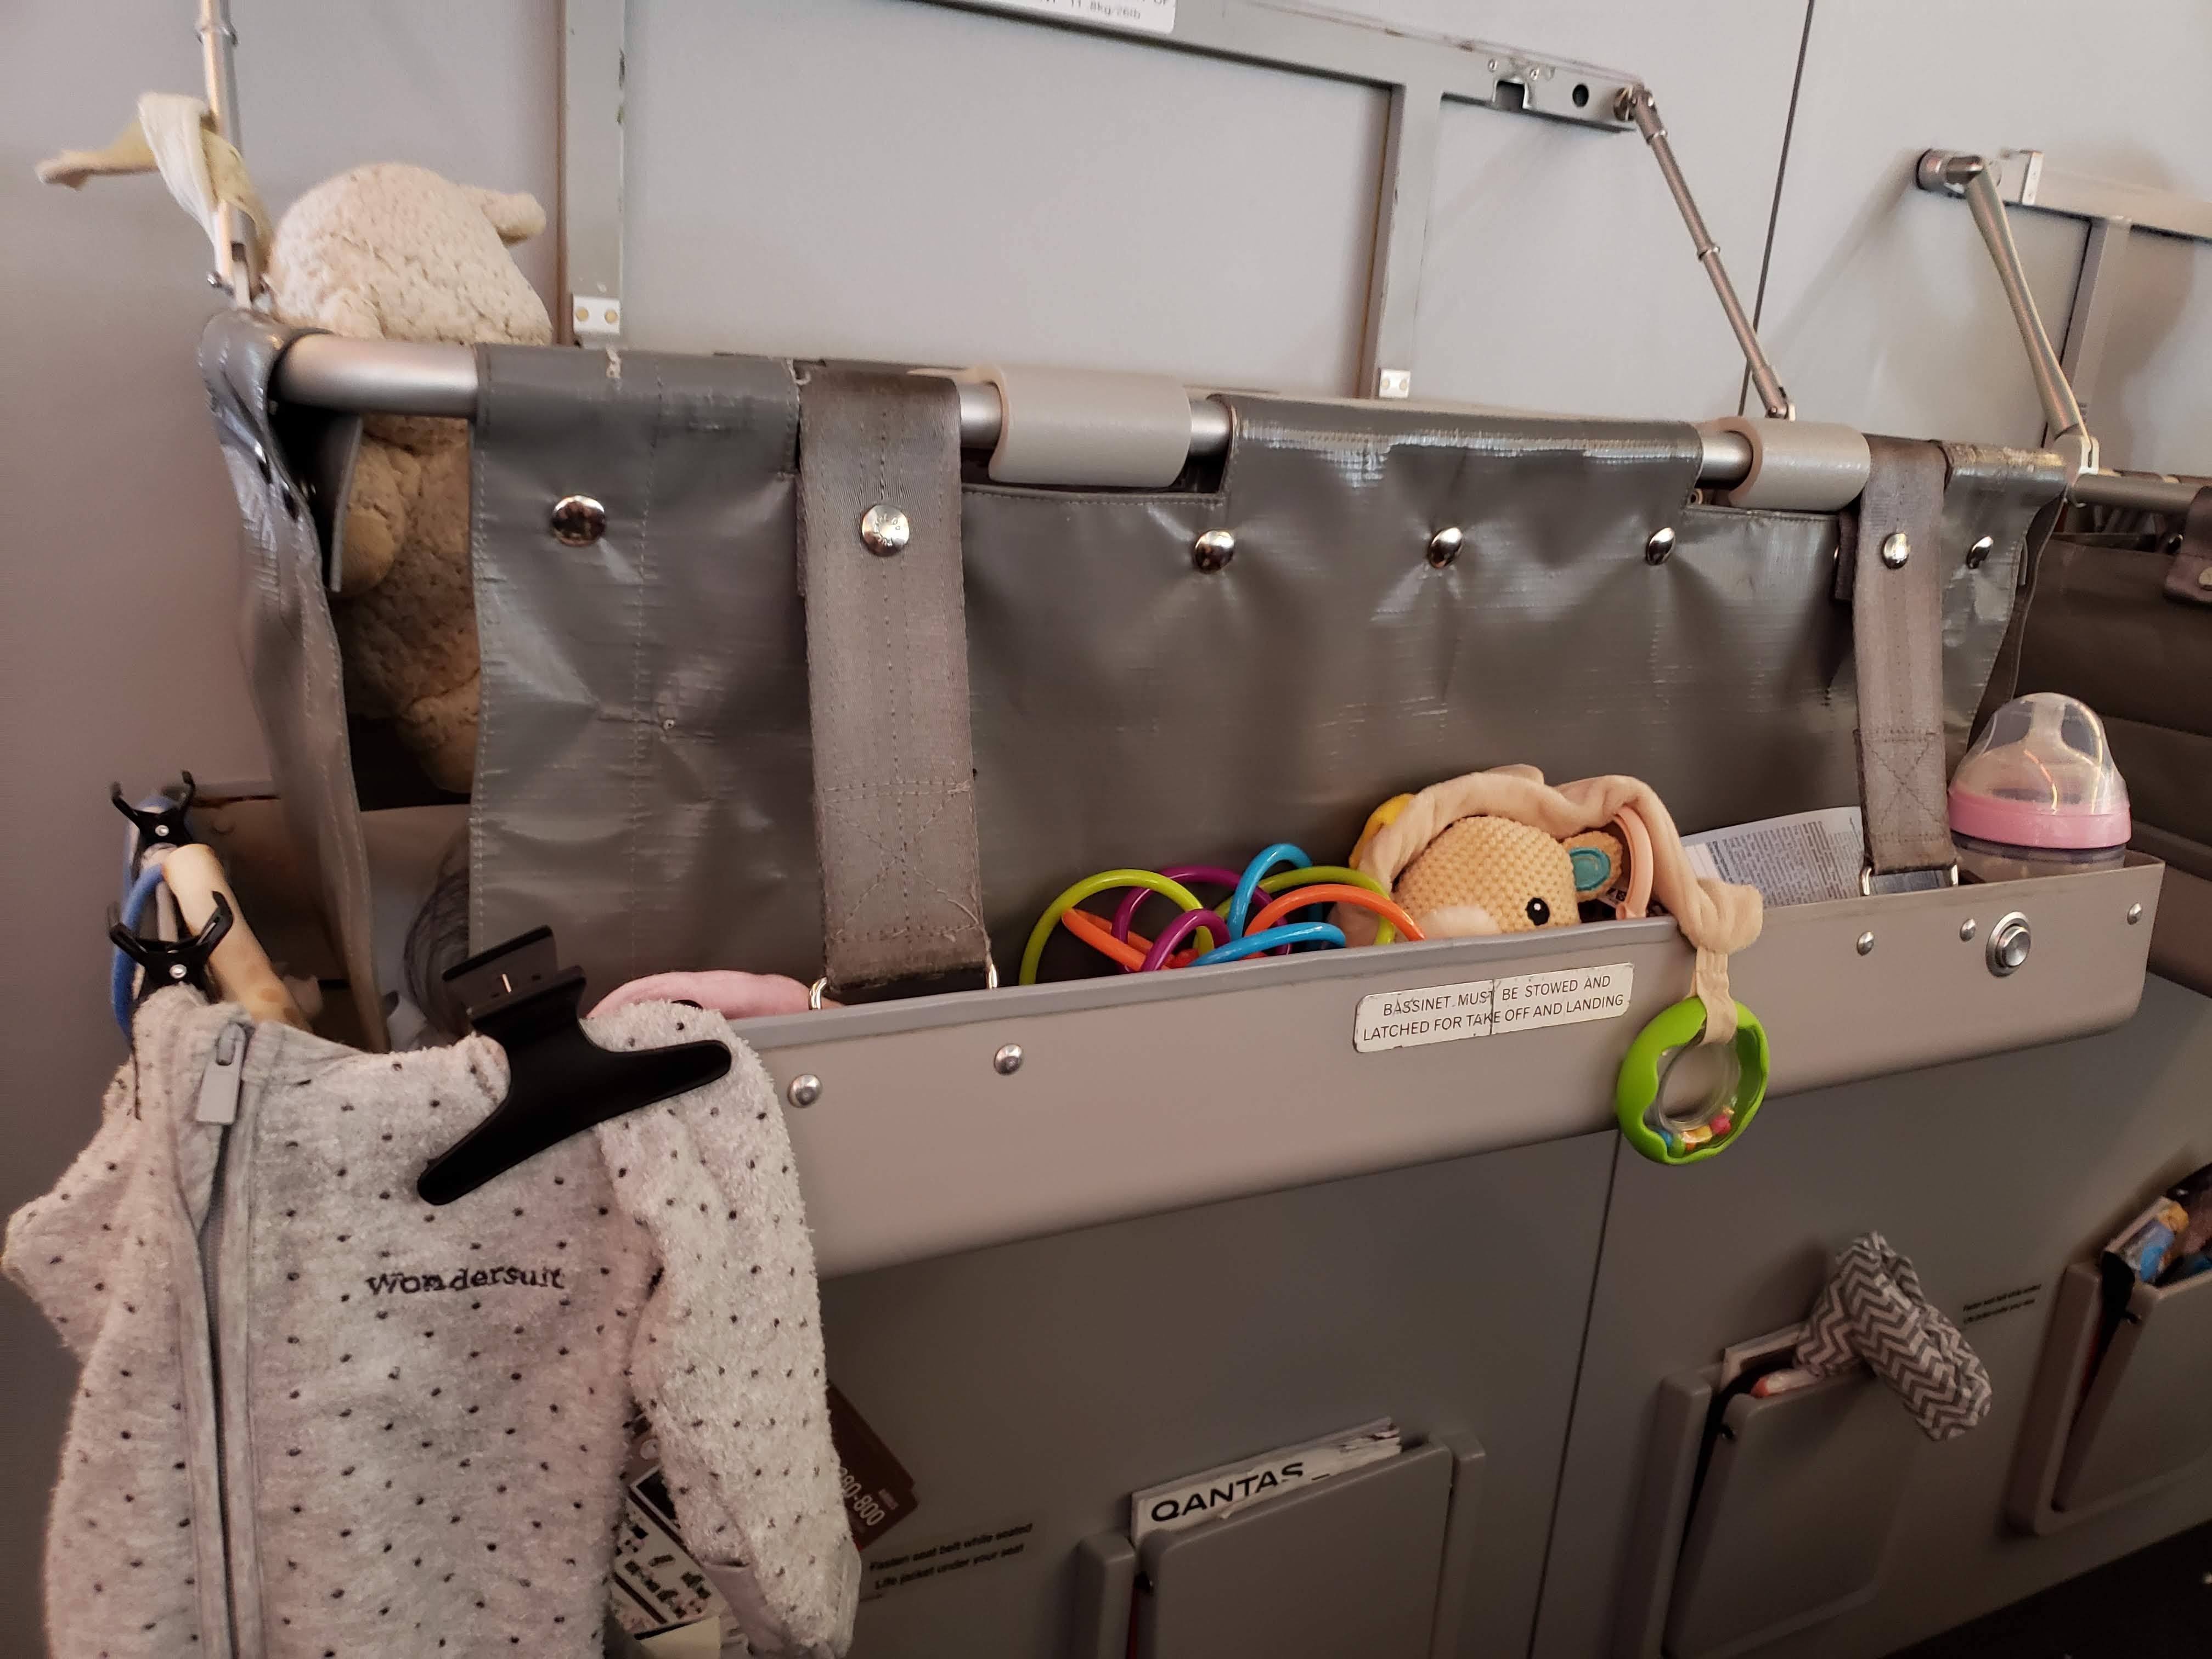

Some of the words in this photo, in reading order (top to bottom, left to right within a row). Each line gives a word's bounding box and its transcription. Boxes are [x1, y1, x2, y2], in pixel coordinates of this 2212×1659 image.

[1363, 1020, 1430, 1041] LATCHED
[1434, 1015, 1462, 1030] FOR
[1467, 1010, 1501, 1025] TAKE
[1504, 1003, 1530, 1019] OFF
[1532, 1000, 1562, 1016] AND
[1566, 994, 1624, 1012] LANDING
[1383, 996, 1452, 1016] BASSINET
[1457, 990, 1495, 1005] MUST
[1502, 986, 1518, 1001] BE
[1525, 979, 1578, 997] STOWED
[1583, 975, 1611, 989] AND
[1151, 1462, 1304, 1522] QANTAS
